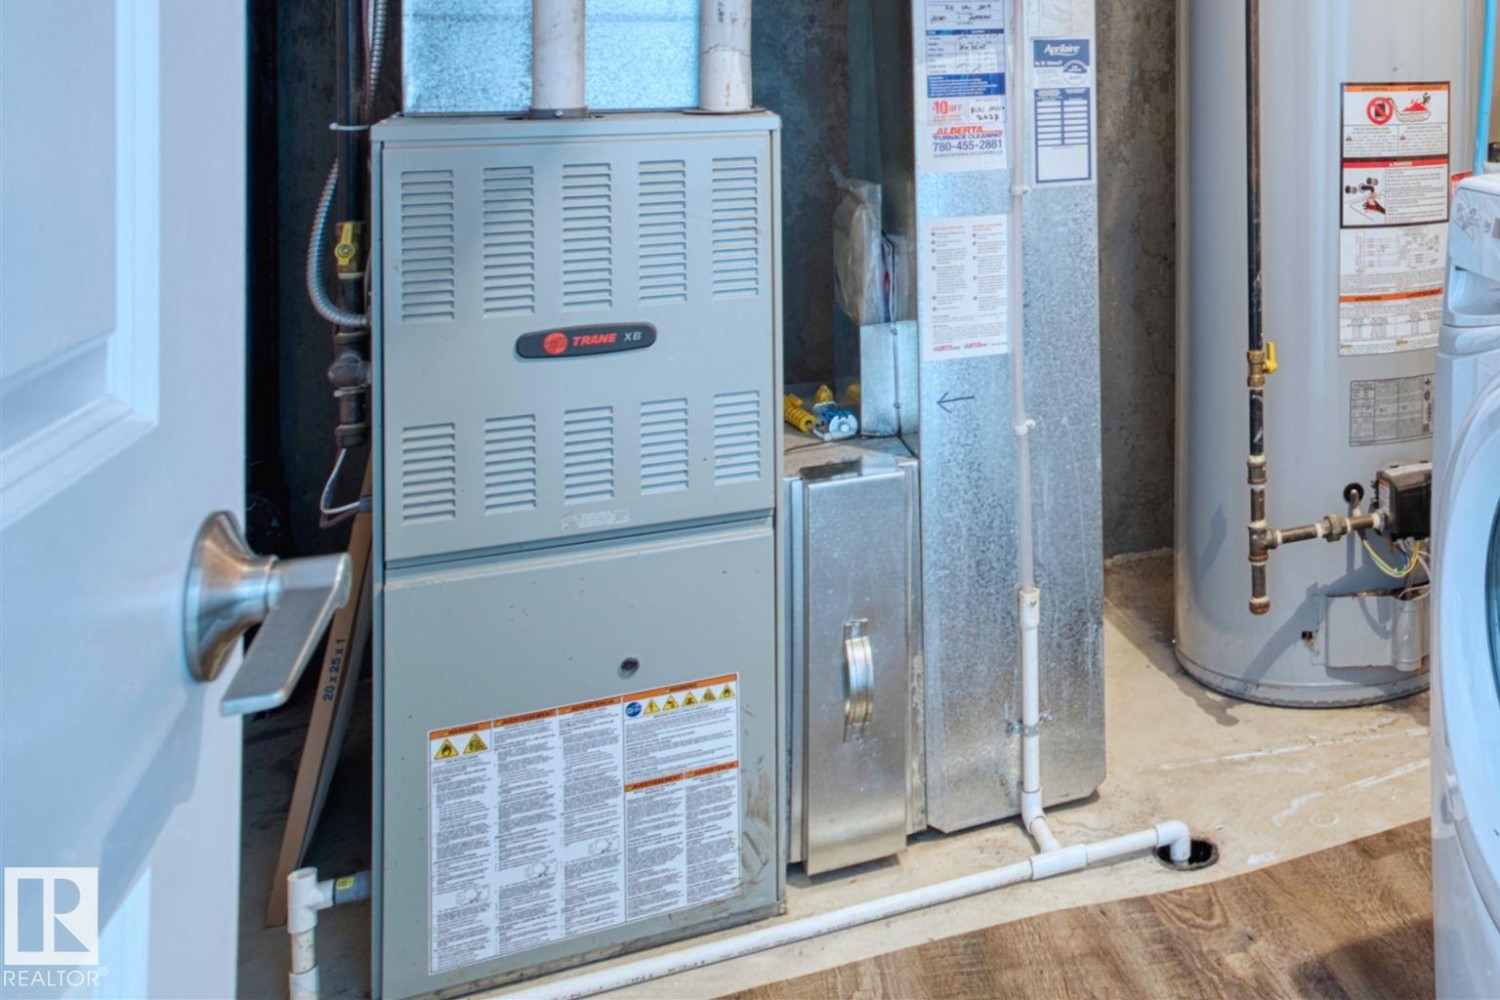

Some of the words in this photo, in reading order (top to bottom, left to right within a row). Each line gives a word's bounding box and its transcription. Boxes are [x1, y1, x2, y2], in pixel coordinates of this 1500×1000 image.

[1044, 43, 1080, 56] Aprilaire
[936, 125, 984, 135] ALBERTA
[933, 140, 1002, 153] 780-455-2881
[572, 333, 618, 347] TRANE
[323, 685, 335, 701] 20
[330, 658, 342, 672] 25
